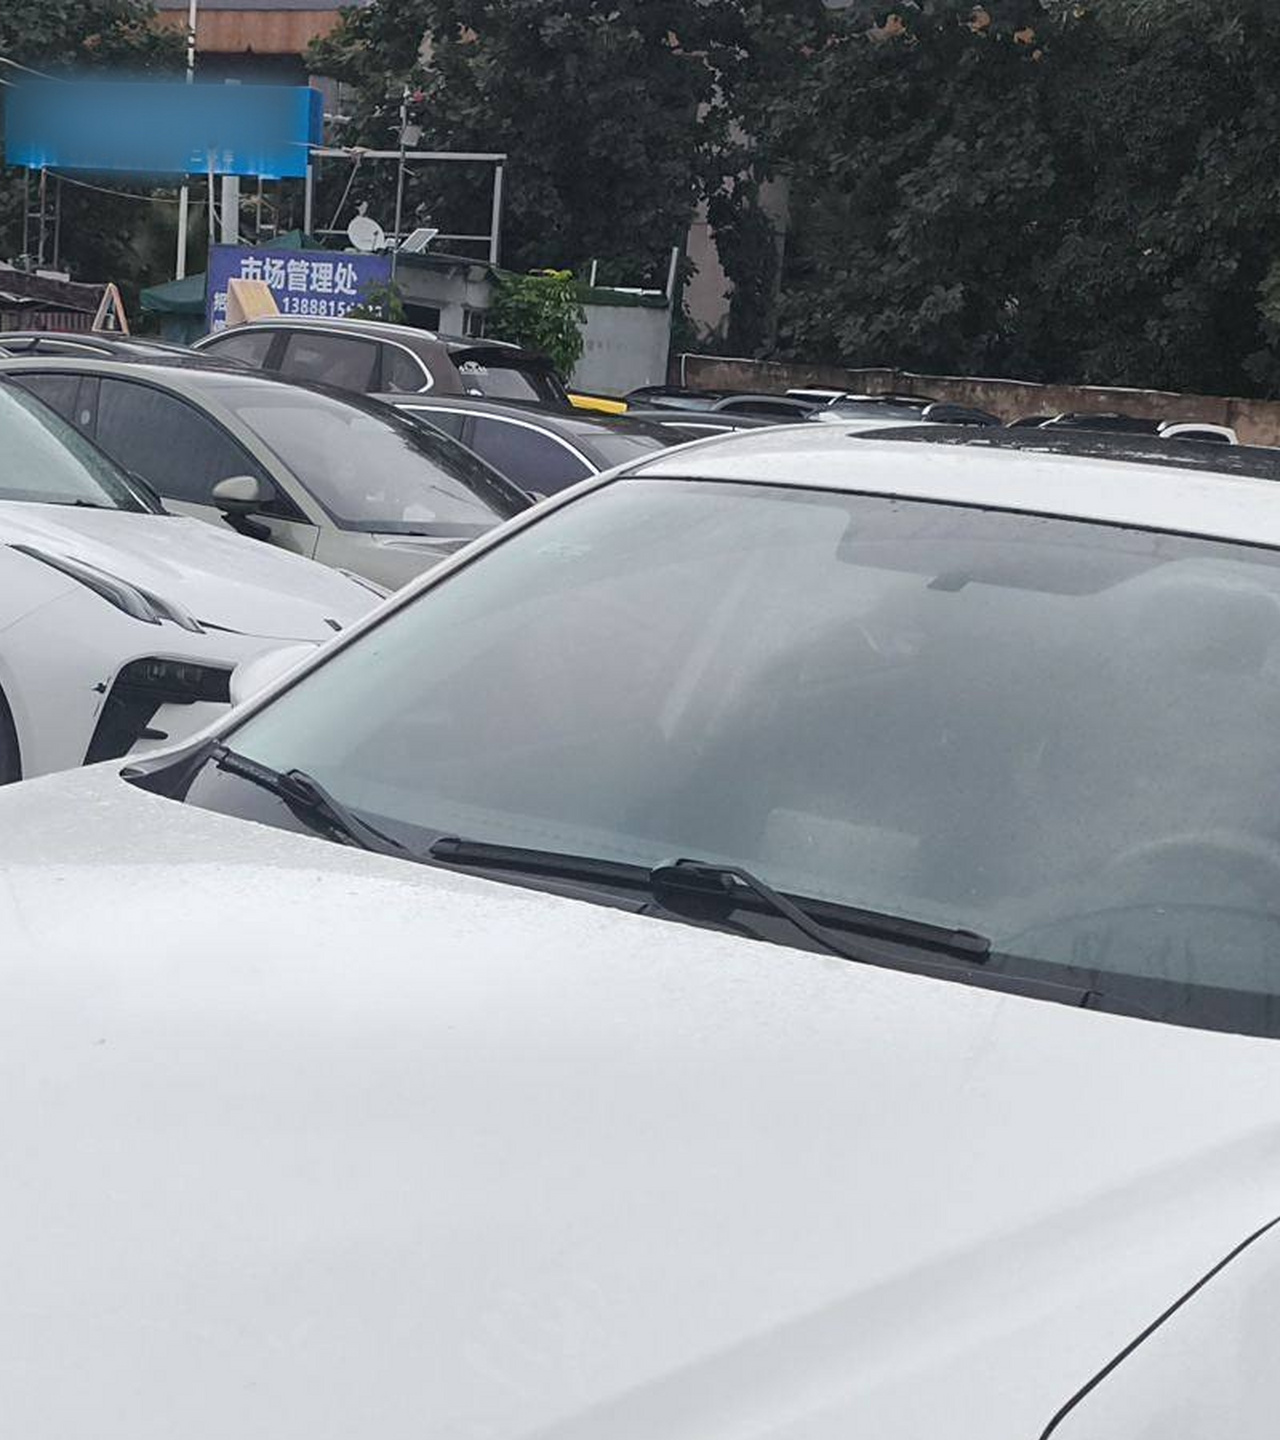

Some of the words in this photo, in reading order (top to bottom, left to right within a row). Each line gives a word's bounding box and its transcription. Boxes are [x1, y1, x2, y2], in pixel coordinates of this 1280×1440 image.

[240, 256, 358, 295] 市场管理处
